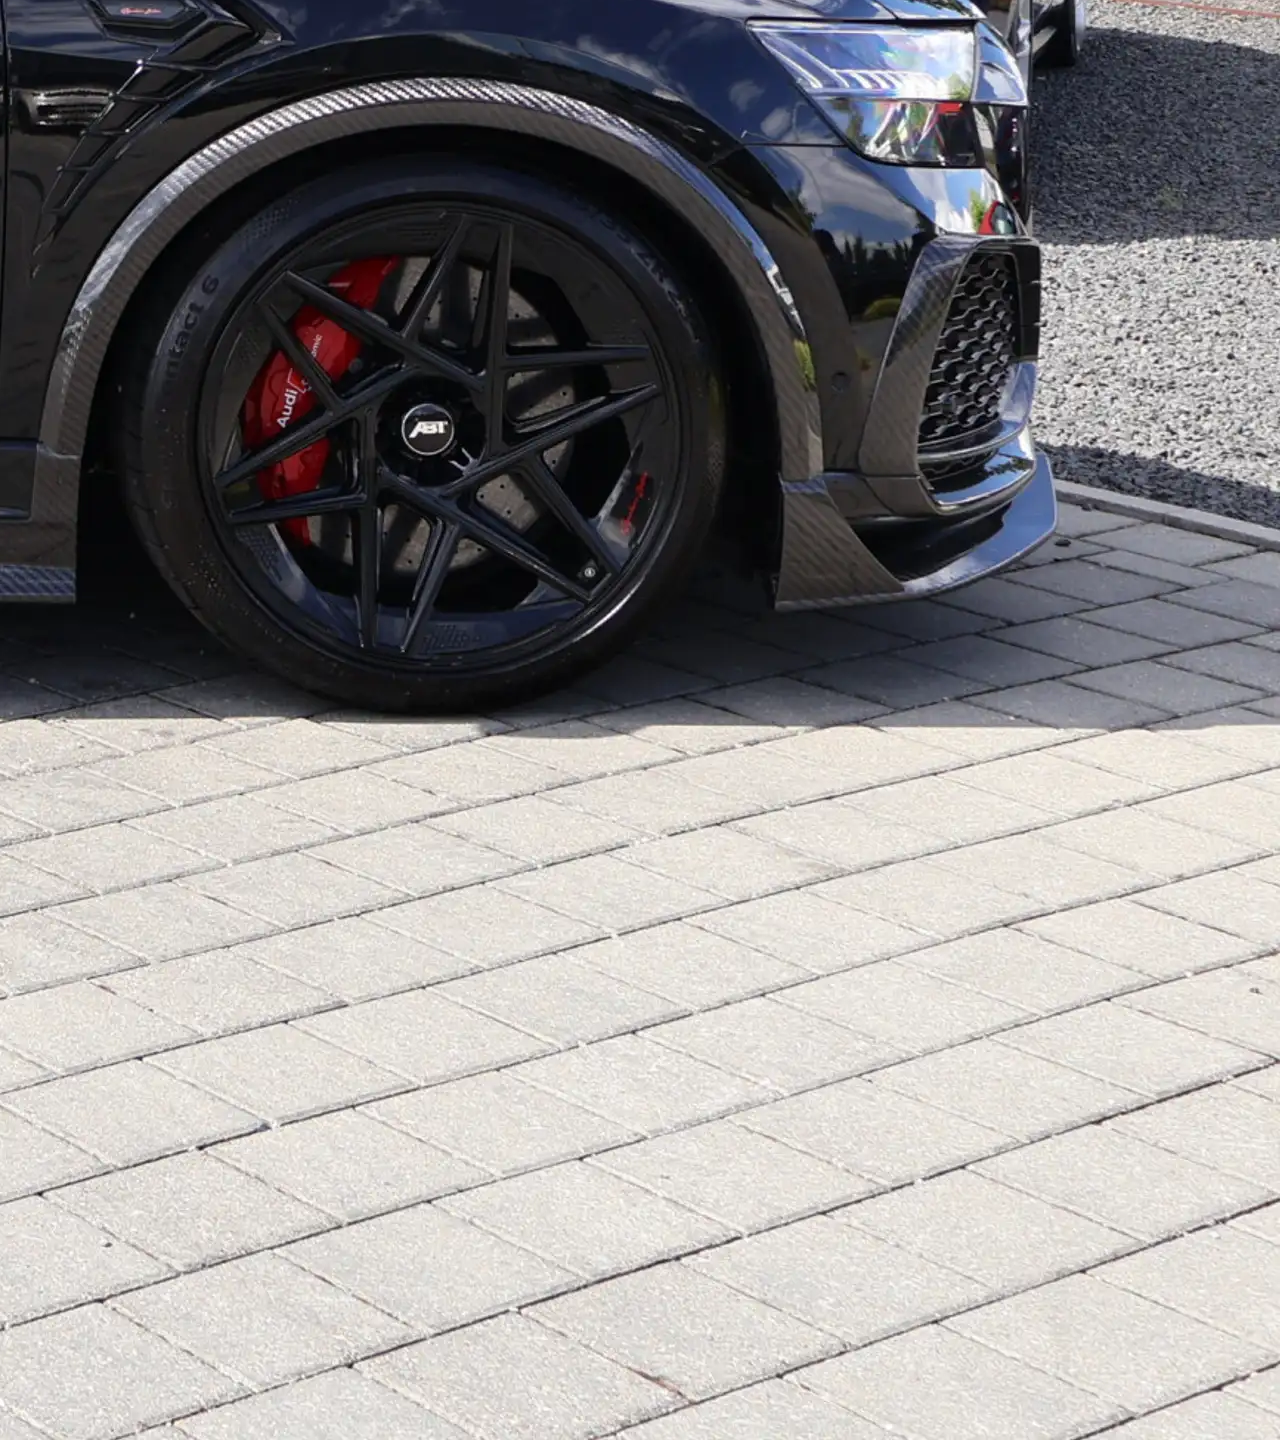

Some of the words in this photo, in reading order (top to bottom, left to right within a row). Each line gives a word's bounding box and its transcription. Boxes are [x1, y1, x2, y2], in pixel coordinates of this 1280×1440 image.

[200, 273, 221, 297] 6
[276, 388, 298, 428] Audi
[409, 421, 449, 438] ABT
